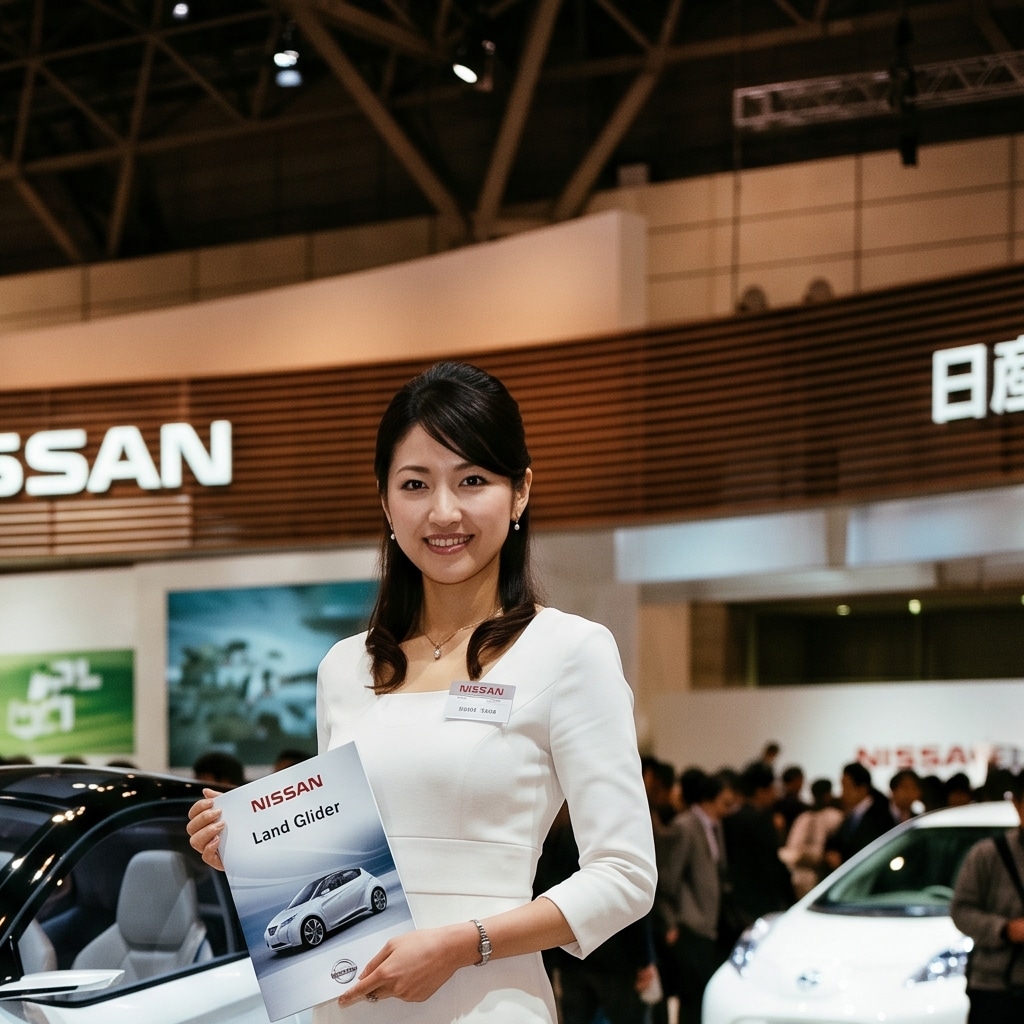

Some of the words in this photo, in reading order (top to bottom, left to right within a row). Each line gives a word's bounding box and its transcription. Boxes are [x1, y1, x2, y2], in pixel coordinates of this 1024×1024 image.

[459, 684, 504, 696] NISSAN
[250, 774, 324, 813] NISSAN
[252, 819, 291, 845] Land
[293, 802, 340, 828] Glider
